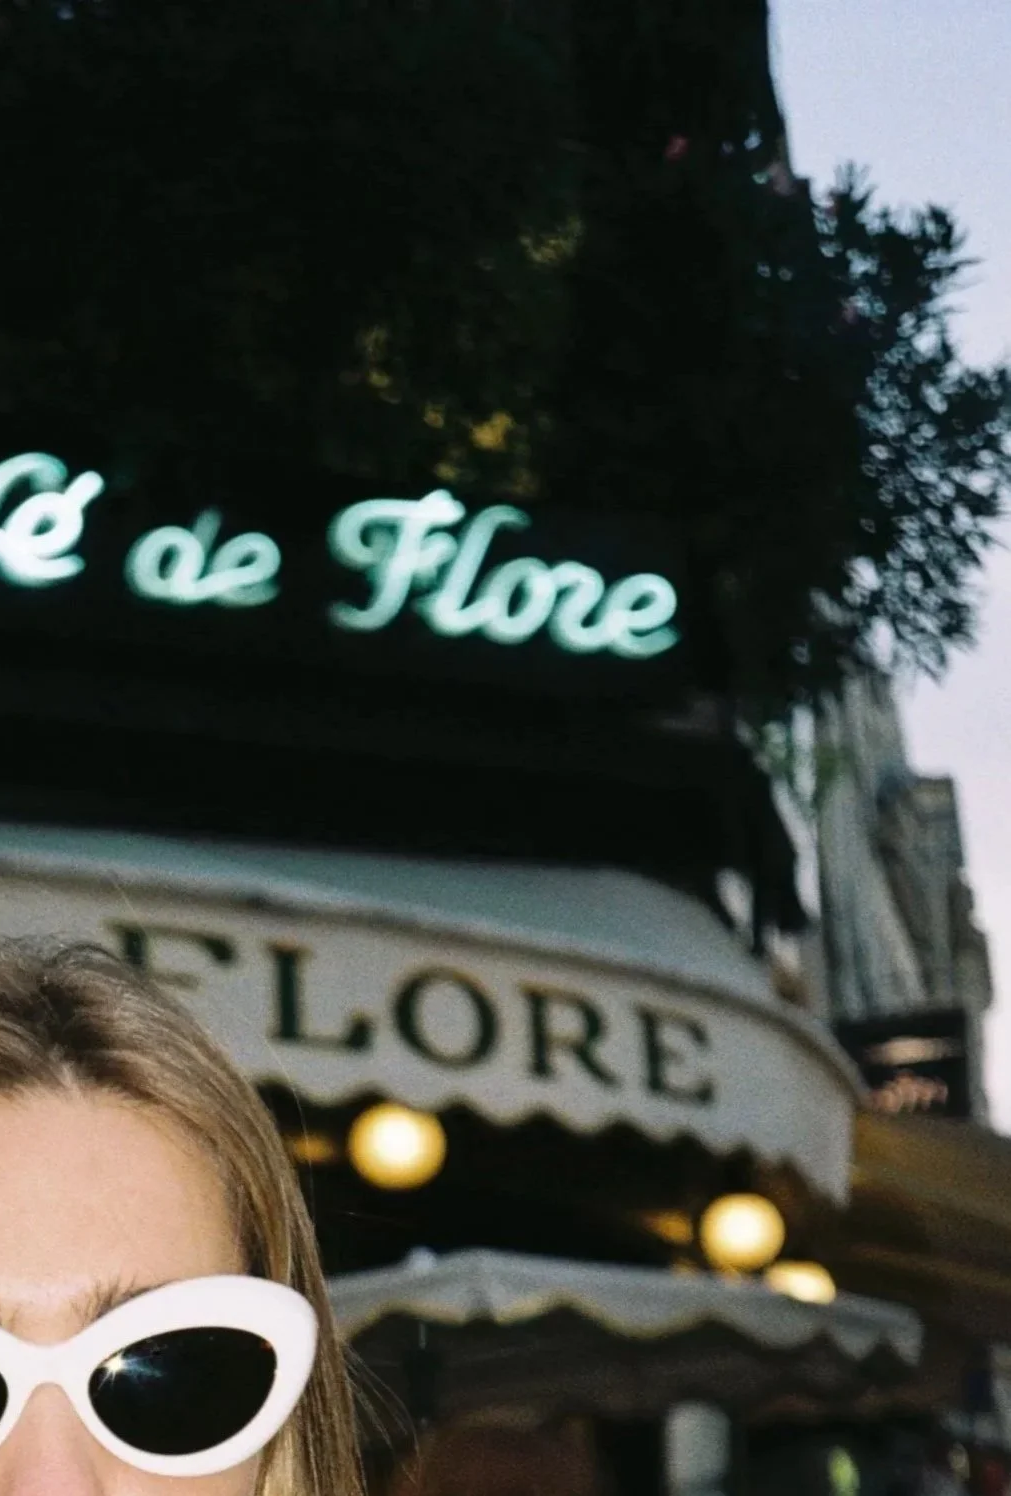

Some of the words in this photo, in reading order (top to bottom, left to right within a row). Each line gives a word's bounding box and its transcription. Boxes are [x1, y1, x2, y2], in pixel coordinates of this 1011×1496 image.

[125, 508, 282, 607] de
[327, 489, 681, 660] Flore
[106, 918, 719, 1107] FLORE
